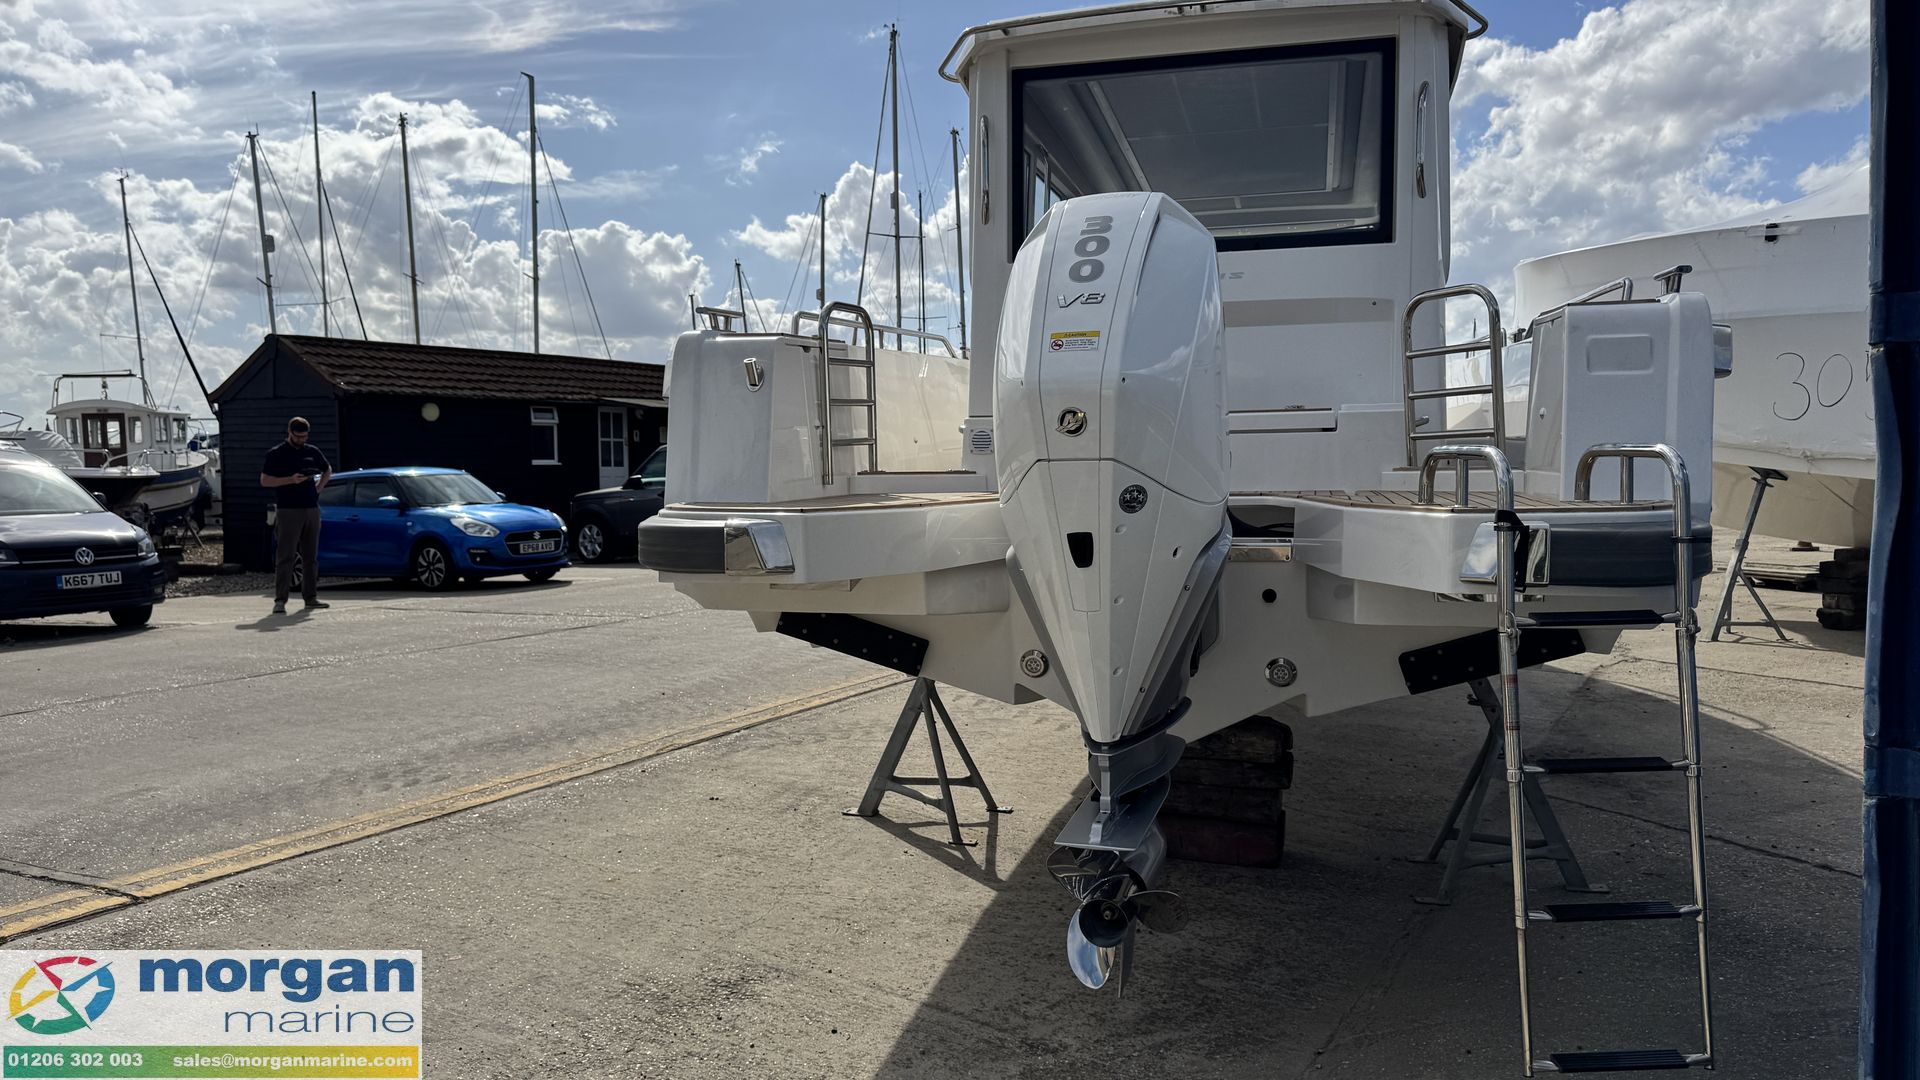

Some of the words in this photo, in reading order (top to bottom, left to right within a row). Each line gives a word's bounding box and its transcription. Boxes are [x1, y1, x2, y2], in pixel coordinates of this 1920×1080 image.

[1069, 215, 1113, 284] 300
[1057, 292, 1105, 308] V8
[98, 573, 120, 584] TUJ
